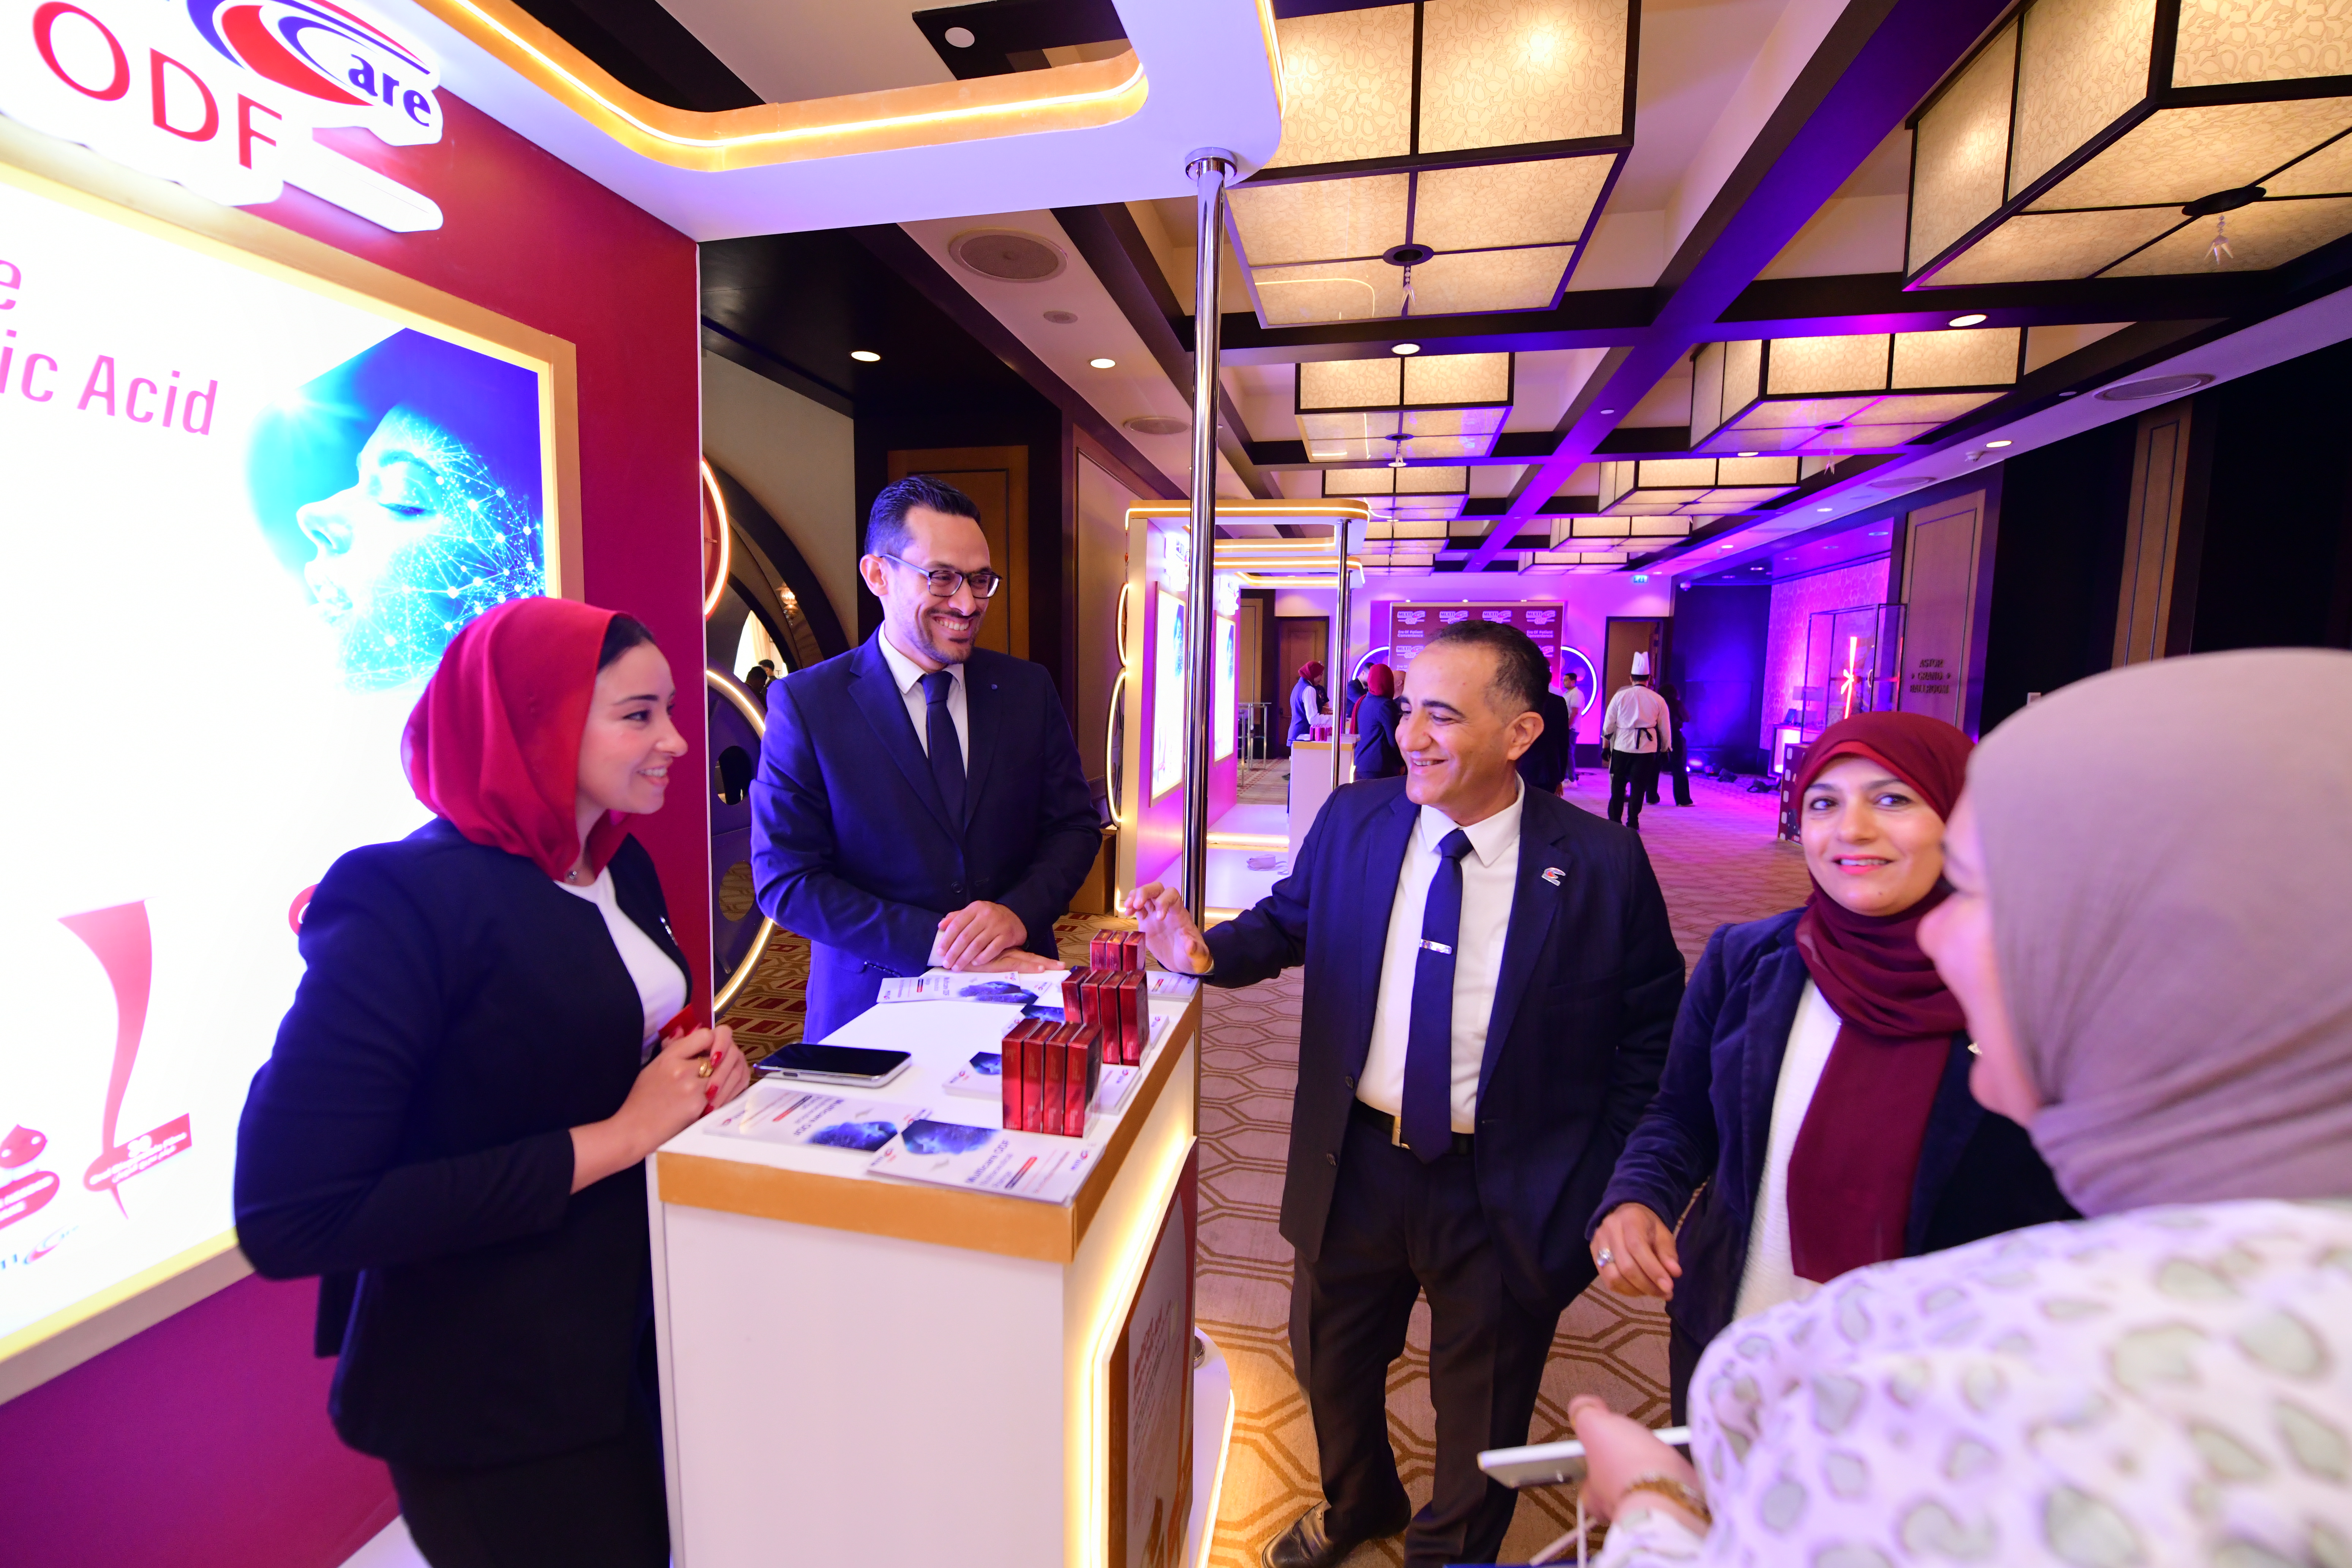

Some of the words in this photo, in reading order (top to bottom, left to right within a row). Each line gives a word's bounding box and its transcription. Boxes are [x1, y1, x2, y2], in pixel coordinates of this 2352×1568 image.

[32, 1, 282, 170] ODF
[77, 354, 218, 436] Acid
[1910, 685, 1949, 693] BALLROOM
[1918, 672, 1943, 680] GRAND
